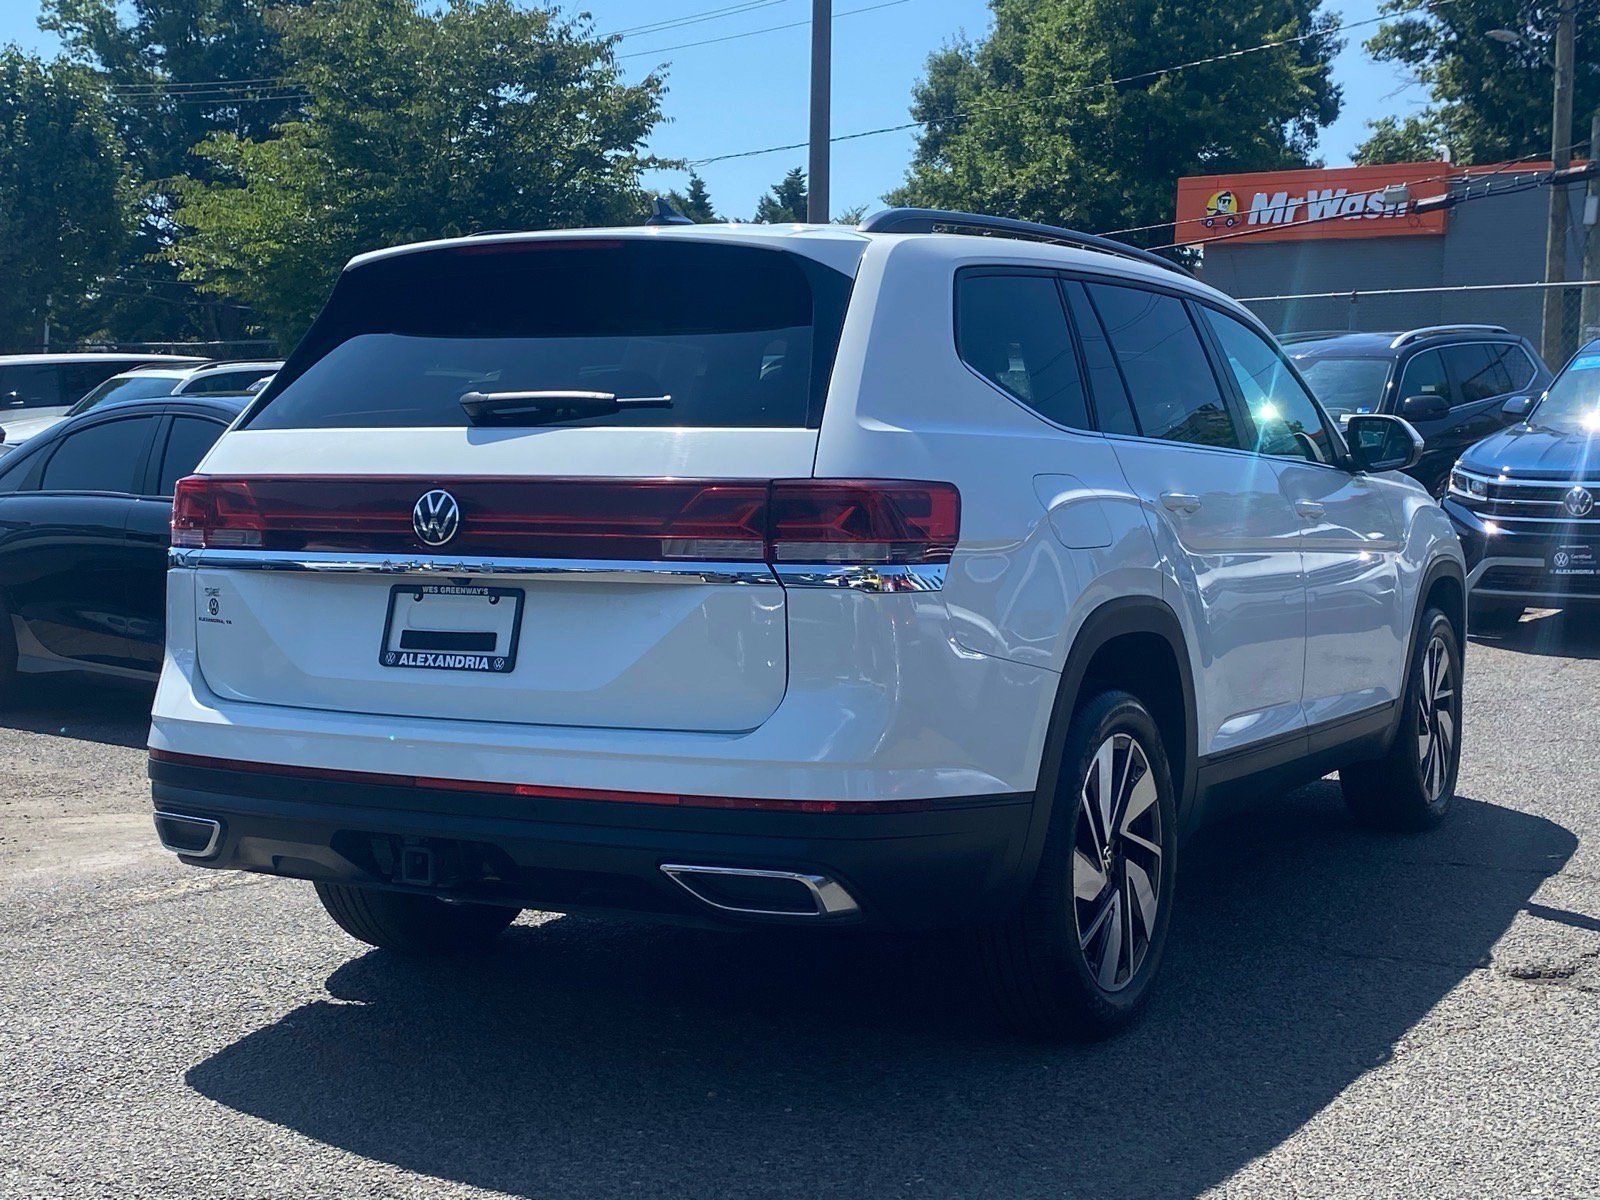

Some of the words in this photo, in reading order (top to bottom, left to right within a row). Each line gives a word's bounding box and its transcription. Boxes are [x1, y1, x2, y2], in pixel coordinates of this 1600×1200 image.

[1247, 191, 1303, 224] Mr
[422, 586, 439, 594] WES
[440, 587, 489, 595] GREENWAY'S
[398, 653, 490, 670] ALEXANDRIA
